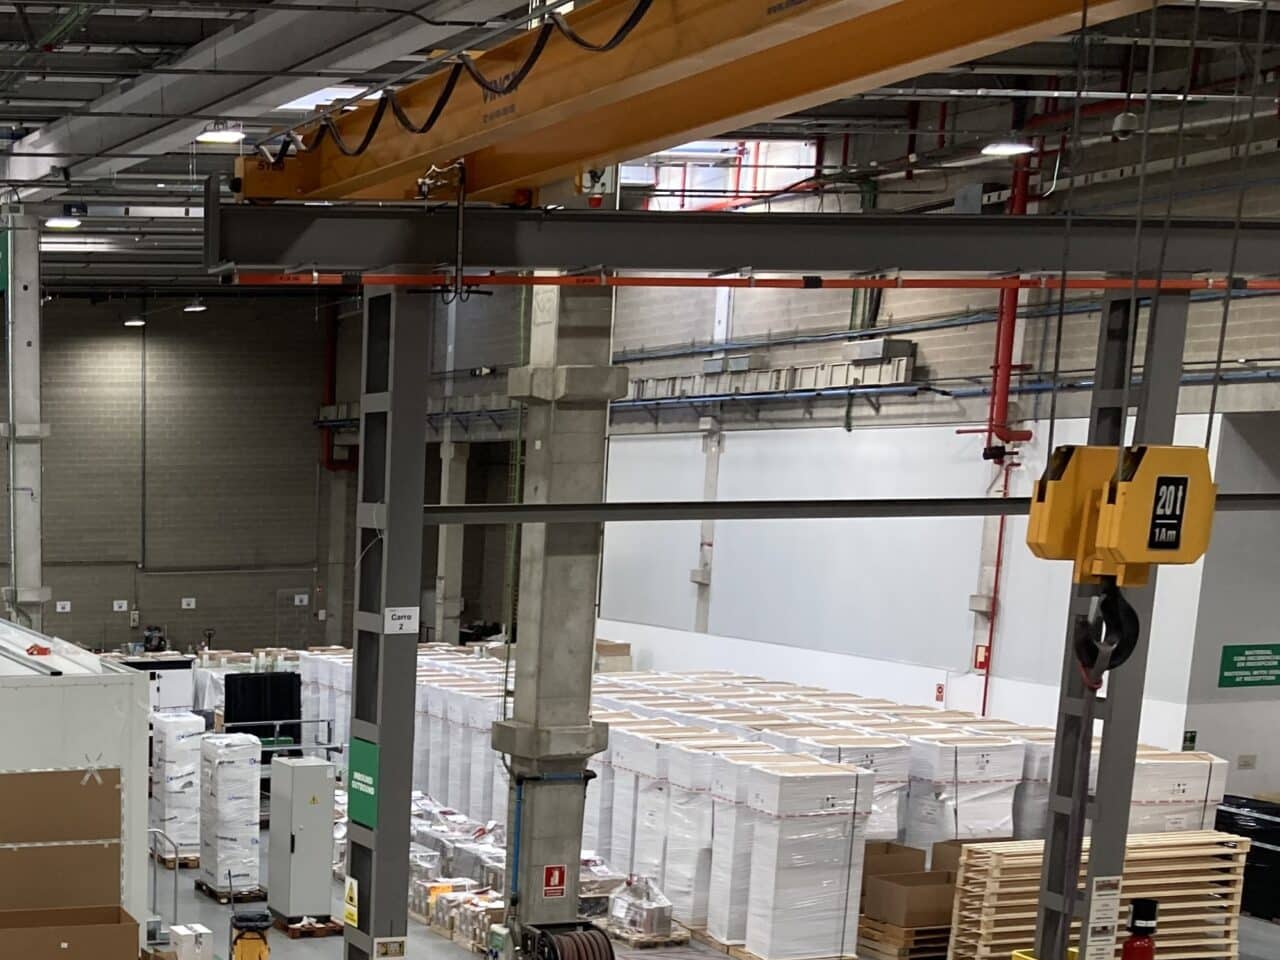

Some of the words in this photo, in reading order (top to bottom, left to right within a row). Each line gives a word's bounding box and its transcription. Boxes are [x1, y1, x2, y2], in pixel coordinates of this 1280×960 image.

[1156, 485, 1176, 515] 20
[1175, 485, 1184, 516] t
[391, 613, 413, 621] Carro
